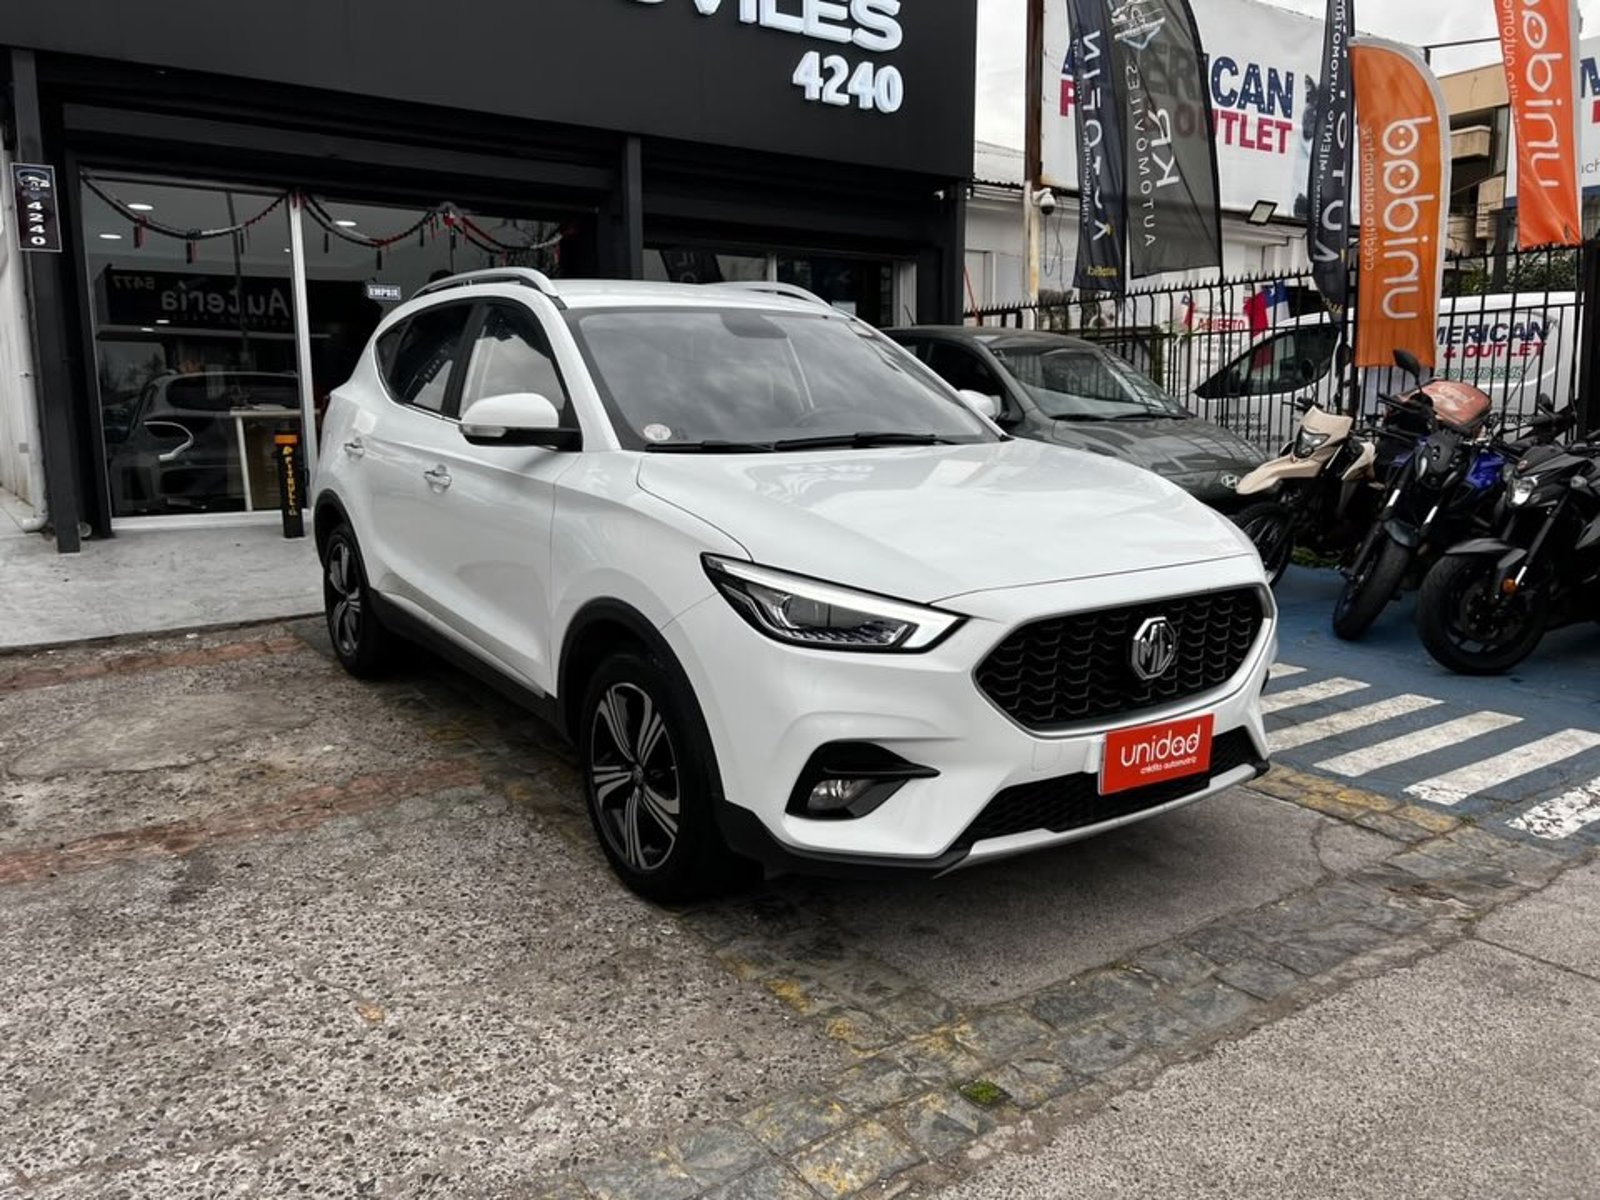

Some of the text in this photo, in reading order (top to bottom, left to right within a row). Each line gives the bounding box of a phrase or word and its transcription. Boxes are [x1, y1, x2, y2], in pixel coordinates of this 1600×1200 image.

[792, 51, 903, 113] 4240
[26, 200, 46, 246] 4240
[1121, 724, 1200, 768] unidad
